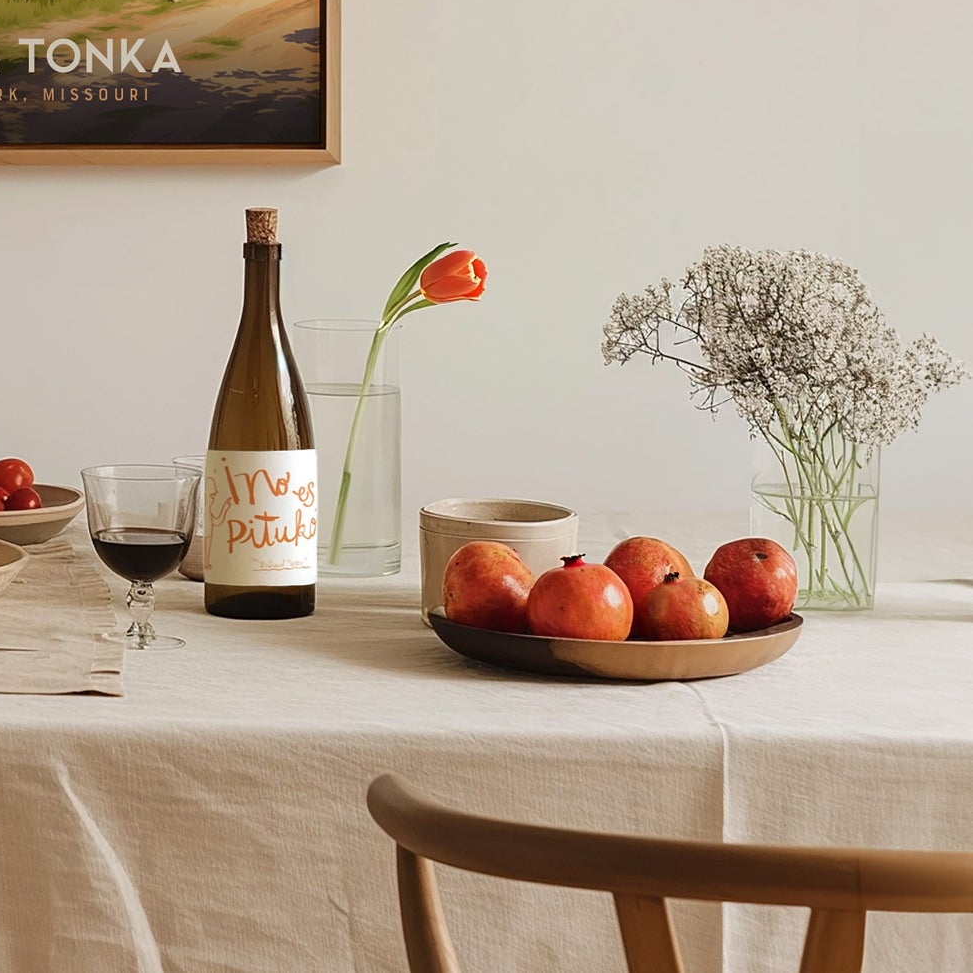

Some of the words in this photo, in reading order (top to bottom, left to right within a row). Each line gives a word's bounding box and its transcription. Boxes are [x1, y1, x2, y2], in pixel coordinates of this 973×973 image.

[18, 38, 182, 73] TONKA
[42, 87, 149, 101] MISSOURI
[292, 481, 315, 508] es
